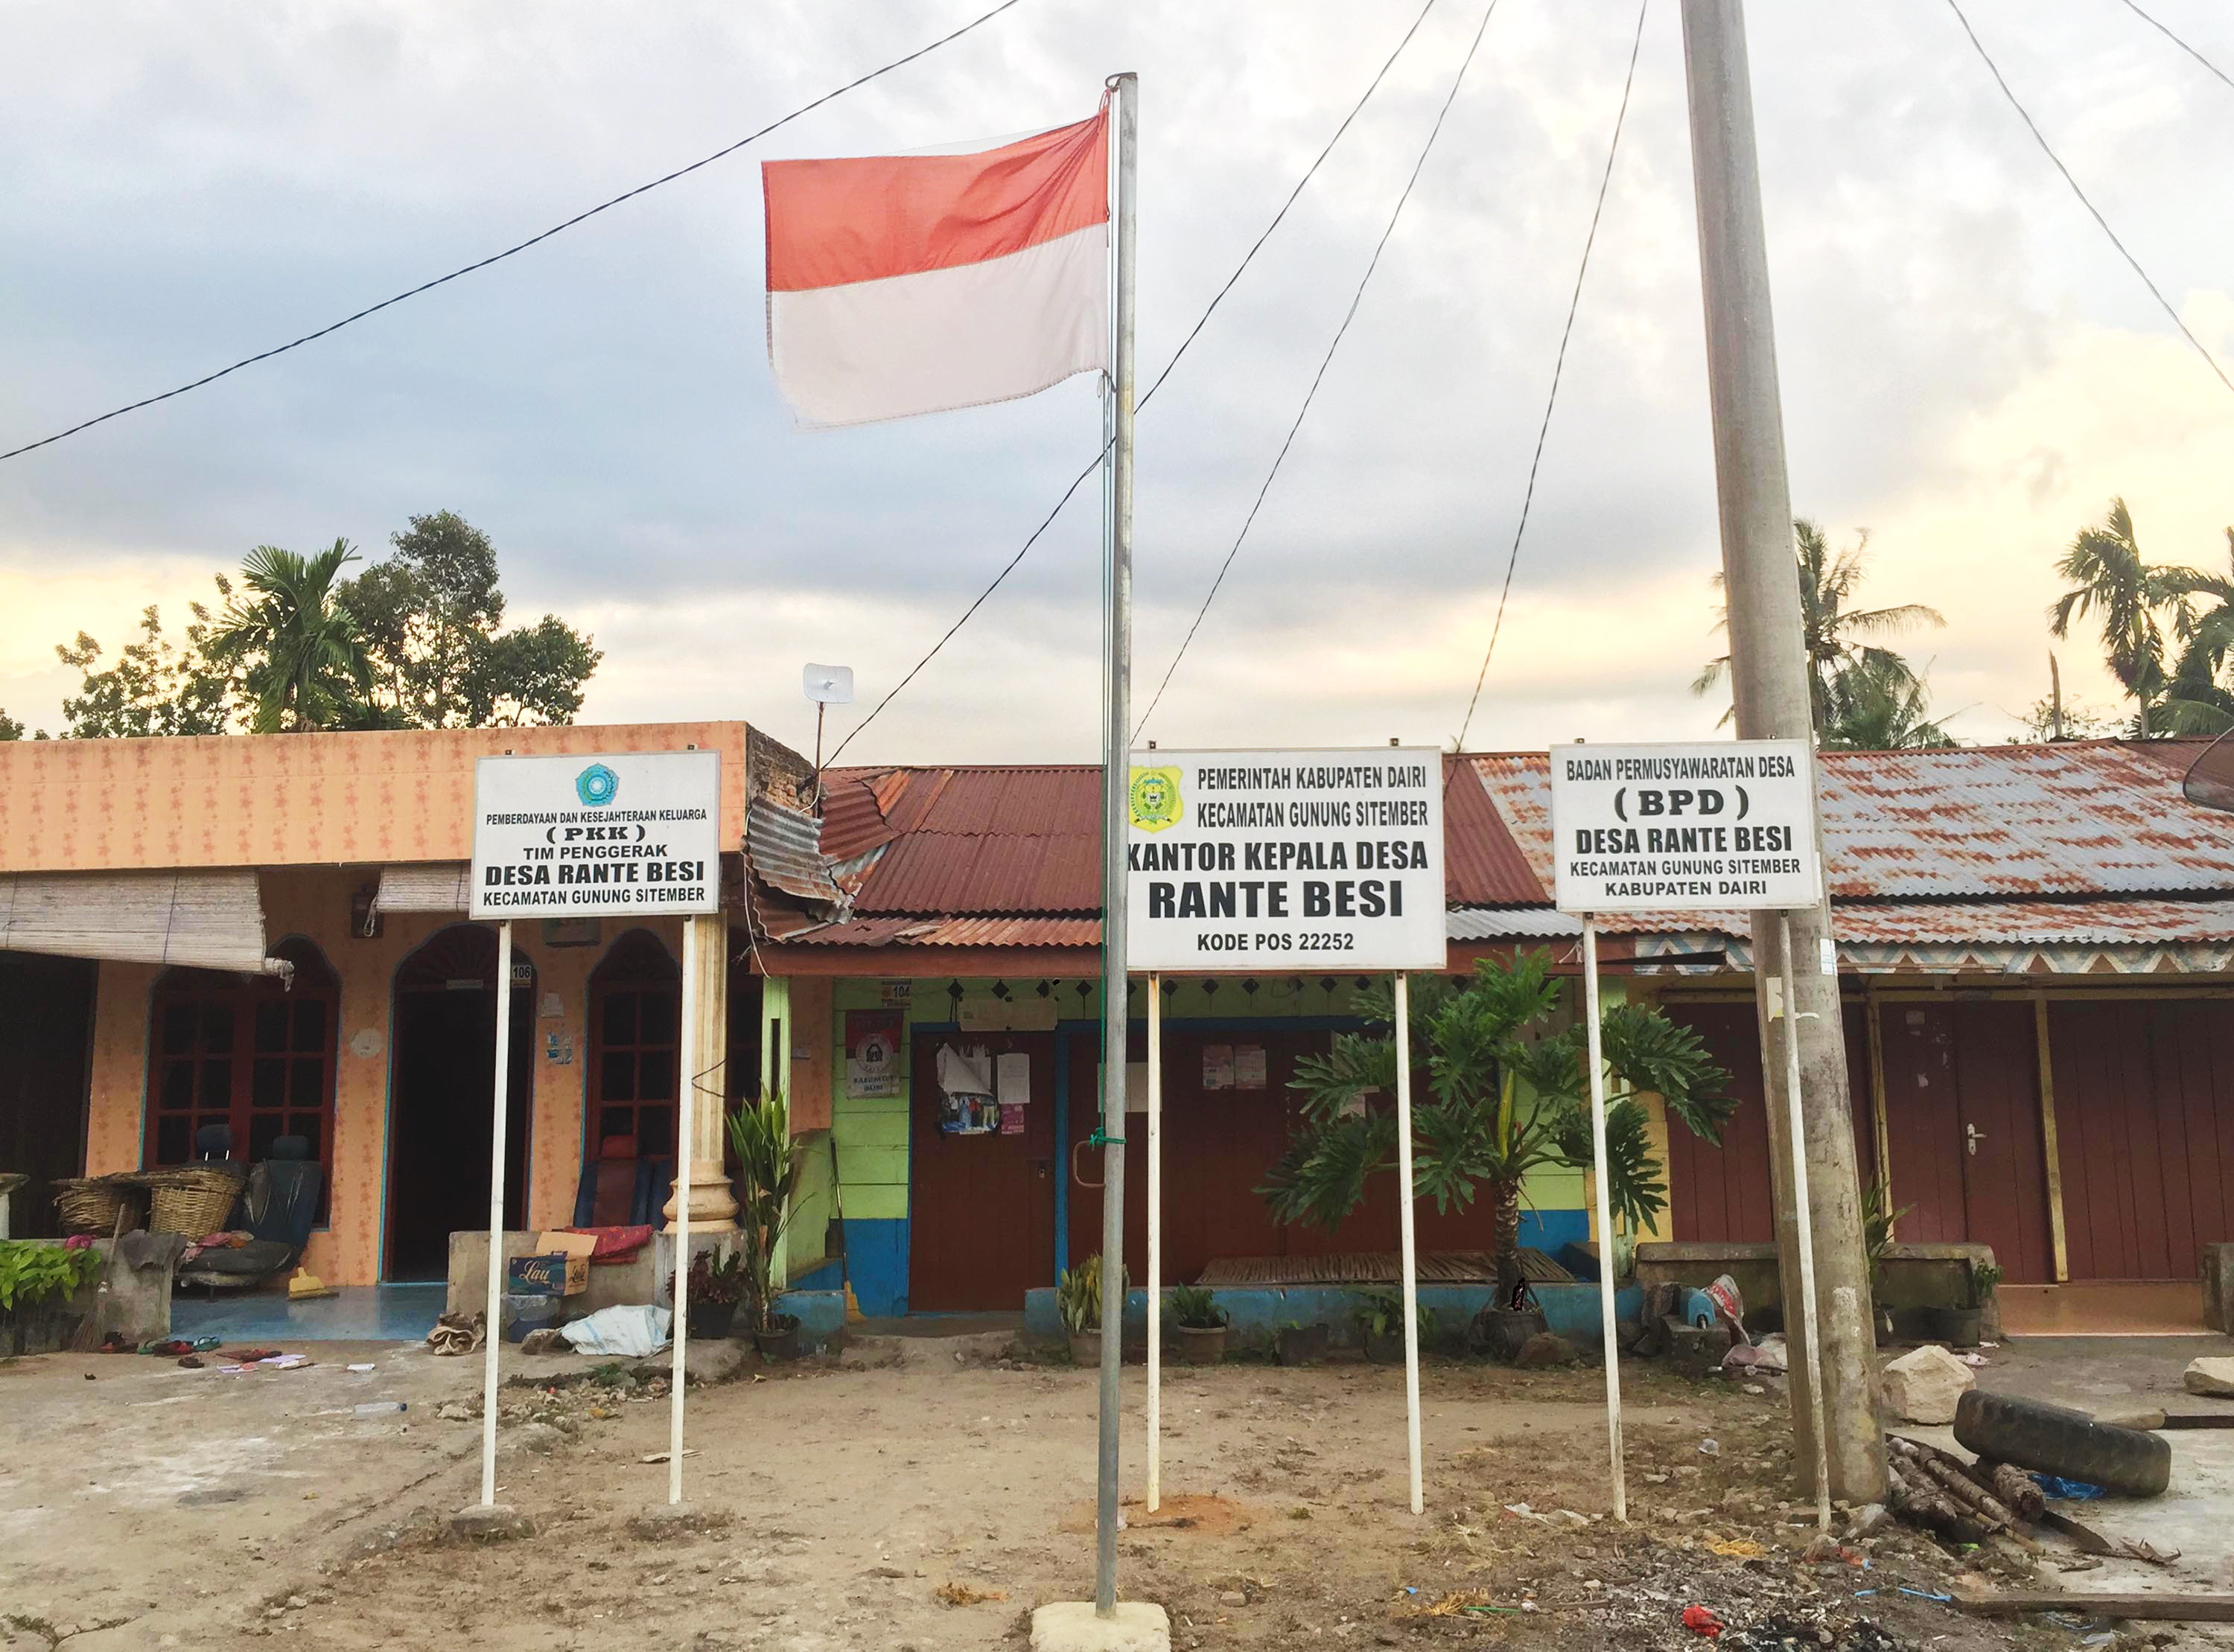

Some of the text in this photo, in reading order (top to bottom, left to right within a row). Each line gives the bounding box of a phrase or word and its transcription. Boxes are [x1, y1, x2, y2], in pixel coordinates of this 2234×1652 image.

[1567, 756, 1795, 780] BADAN PERMUSYAWARATAN DESA
[1199, 766, 1425, 789] PEMERINTAH KABUPATEN DAIRI
[487, 809, 707, 825] PEMBERDAYAAN DAN KESEJAHTERAAN KELUARGA
[1198, 801, 1428, 827] KECAMATAN GUNUNG SITEMBER
[1576, 826, 1791, 854] DESA RANTE BESI
[524, 844, 667, 860] TIM PENGGERAK
[1129, 841, 1428, 871] KANTOR KEPALA DESA
[486, 861, 704, 885] DESA RANTE BESI
[1571, 859, 1800, 876] KECAMATAN GUNUNG SITEMBER
[484, 887, 704, 905] KECAMATAN GUNUNG SITEMBER
[1606, 881, 1766, 896] KABUPATEN DAIRI
[1150, 880, 1401, 918] RANTE BESI
[1198, 934, 1353, 951] KODE POS 22252
[513, 966, 530, 978] 106
[894, 986, 910, 998] 104
